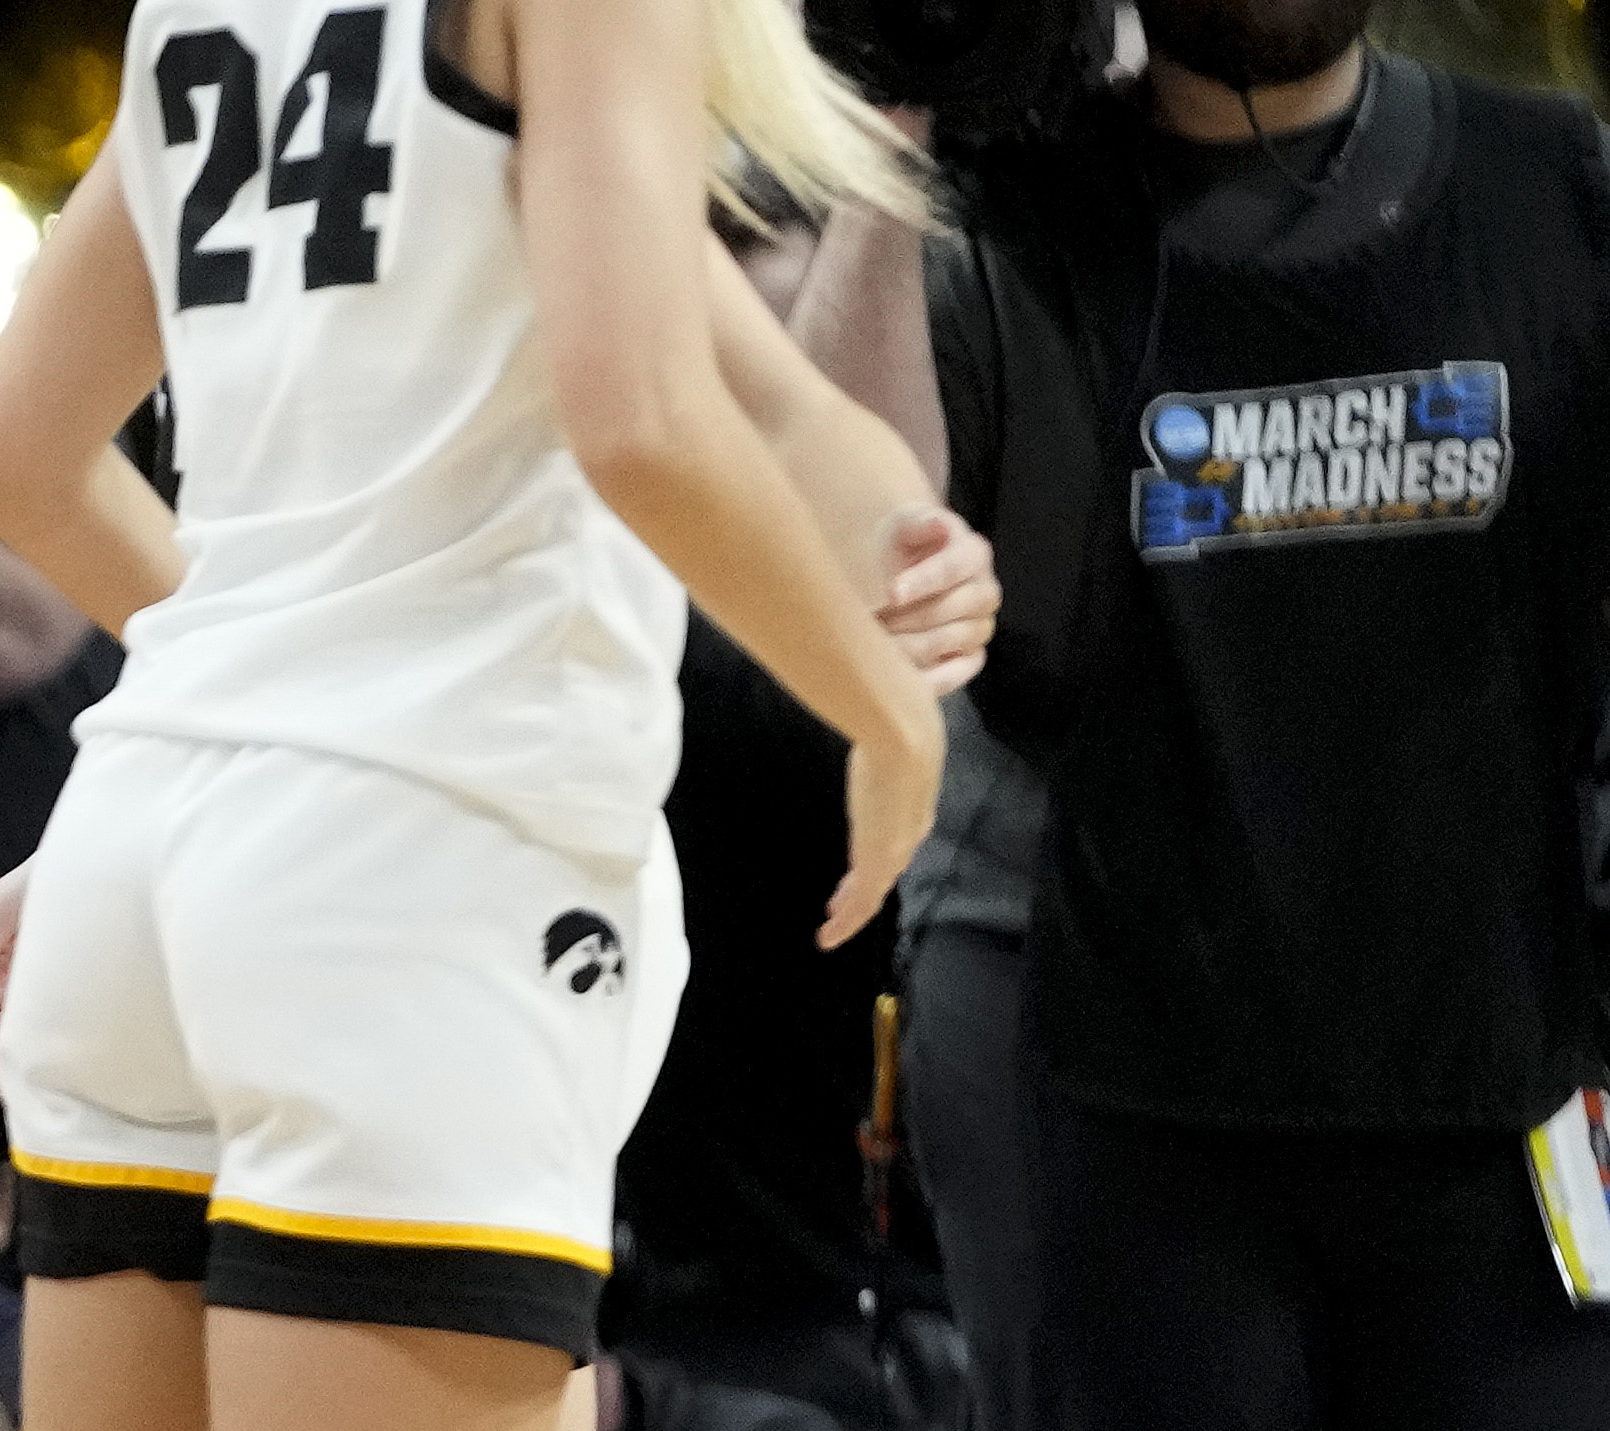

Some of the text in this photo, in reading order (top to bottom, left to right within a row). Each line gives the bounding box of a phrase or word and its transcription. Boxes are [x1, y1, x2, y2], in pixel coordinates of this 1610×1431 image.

[155, 8, 393, 311] 24
[1211, 384, 1407, 462] MARCH
[1240, 438, 1502, 516] MADNESS
